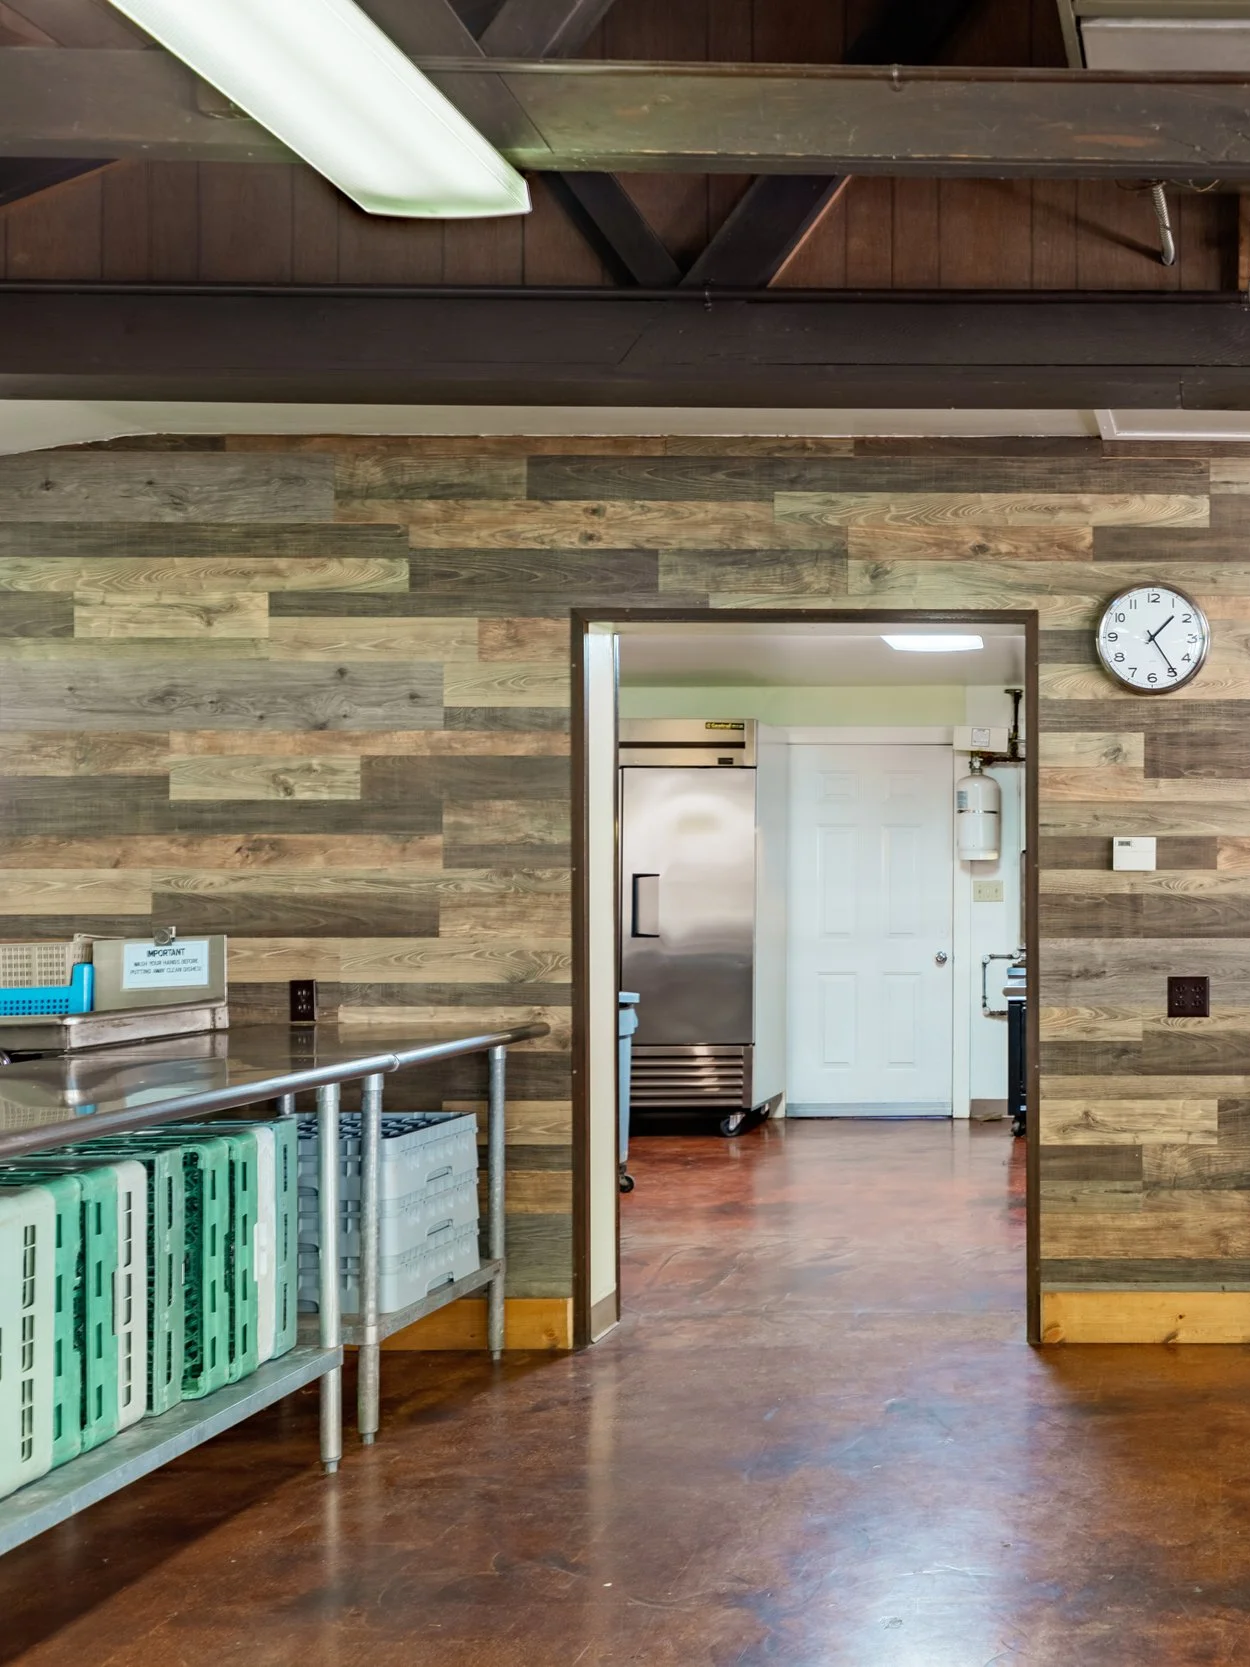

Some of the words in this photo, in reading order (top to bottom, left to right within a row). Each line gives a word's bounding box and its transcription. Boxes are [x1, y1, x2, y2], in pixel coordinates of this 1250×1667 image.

[1147, 593, 1160, 603] 12
[1129, 599, 1137, 609] 11
[1115, 612, 1126, 623] 10
[1182, 613, 1192, 623] 2
[1107, 632, 1118, 642] 9
[1187, 633, 1198, 644] 3
[1114, 652, 1125, 662] 8
[1181, 653, 1191, 663] 4
[1128, 667, 1138, 678] 7
[1167, 667, 1178, 678] 5
[1147, 673, 1158, 683] 6
[147, 948, 185, 958] IMPORTANT
